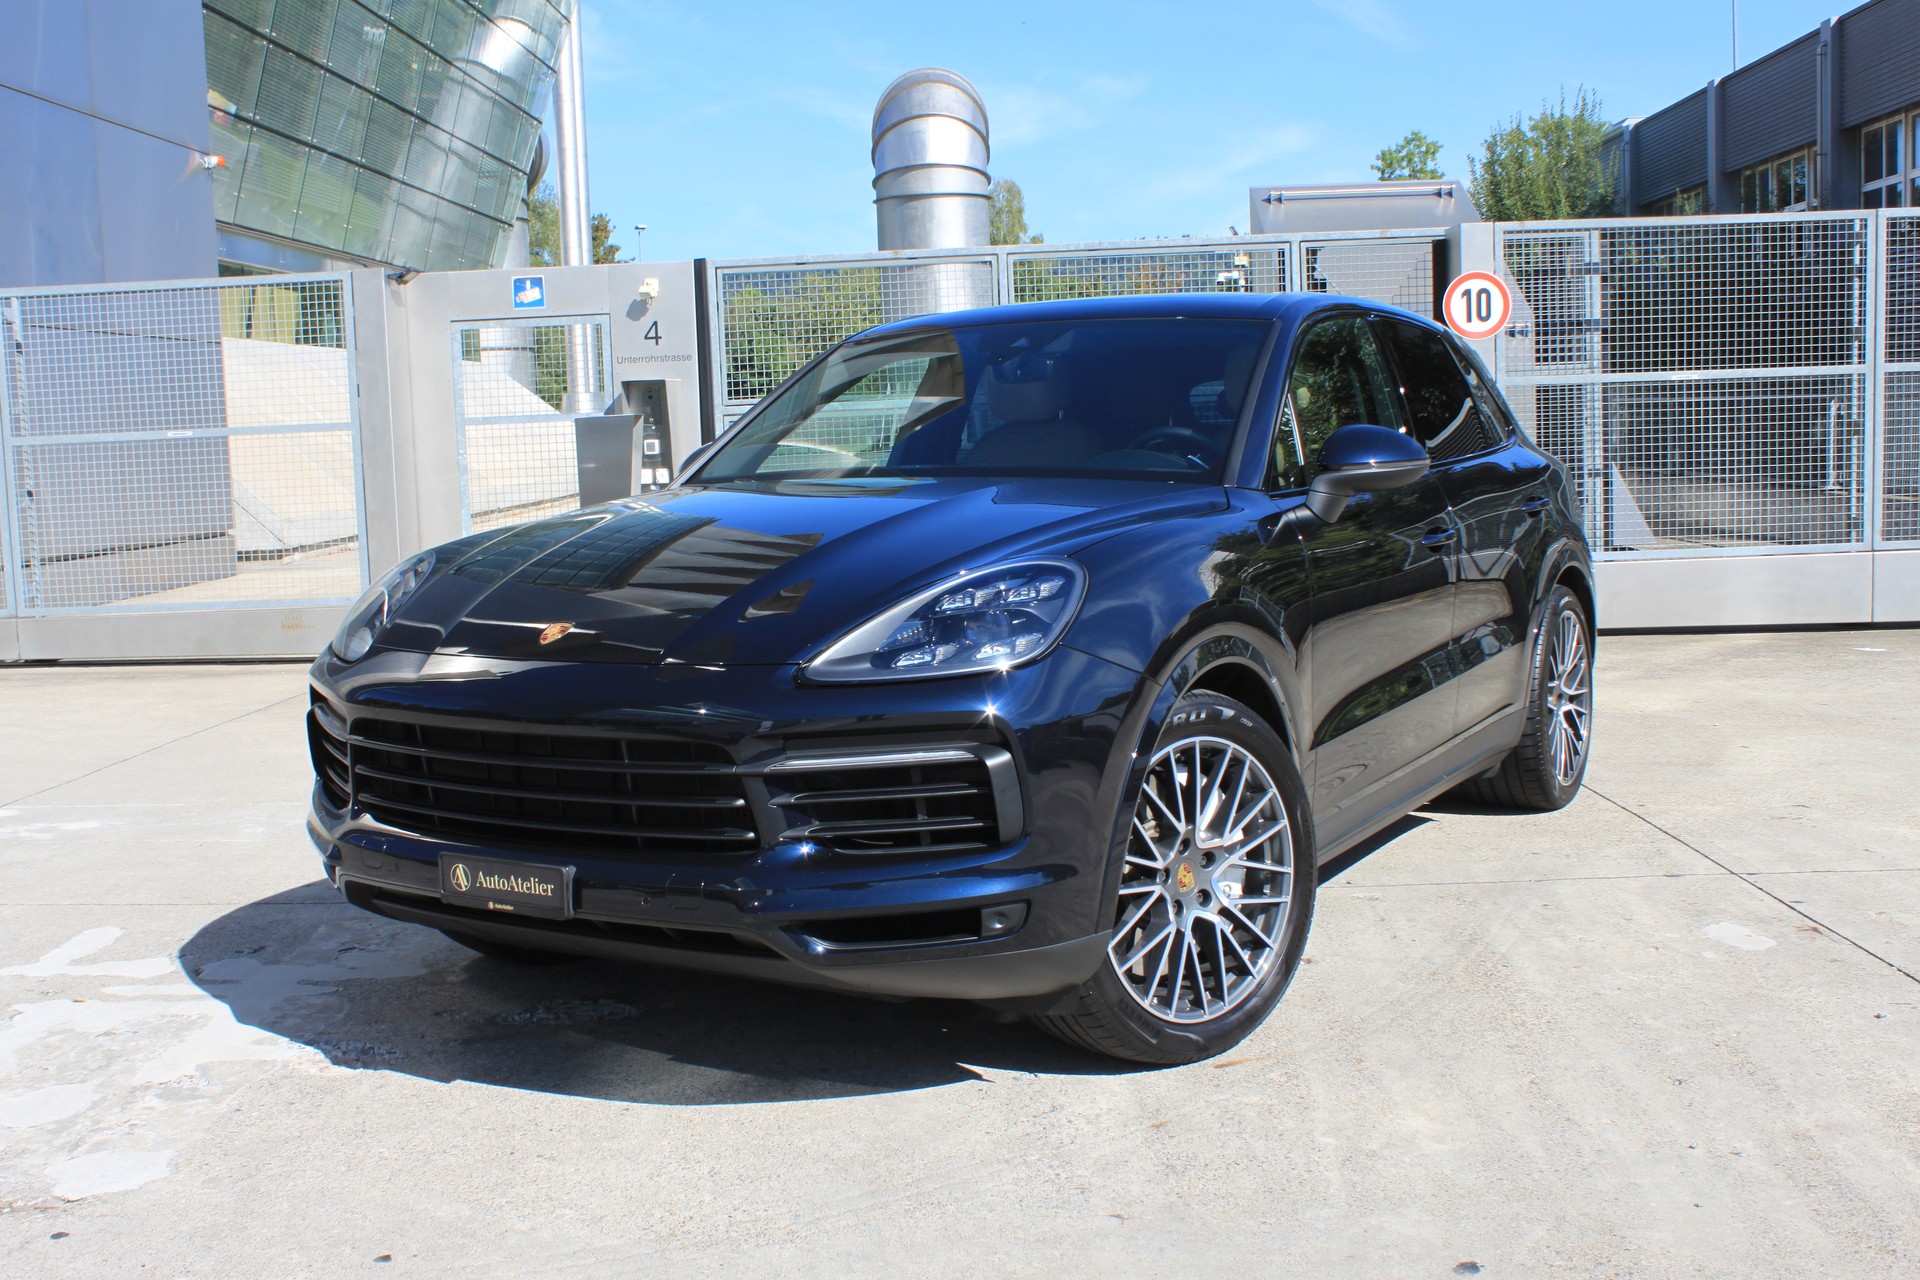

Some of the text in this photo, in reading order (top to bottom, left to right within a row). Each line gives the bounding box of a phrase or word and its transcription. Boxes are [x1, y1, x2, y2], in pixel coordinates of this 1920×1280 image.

[1461, 287, 1491, 323] 10
[644, 320, 662, 346] 4
[616, 353, 692, 365] Unterrohrstrasse
[476, 870, 554, 896] AutoAtelier
